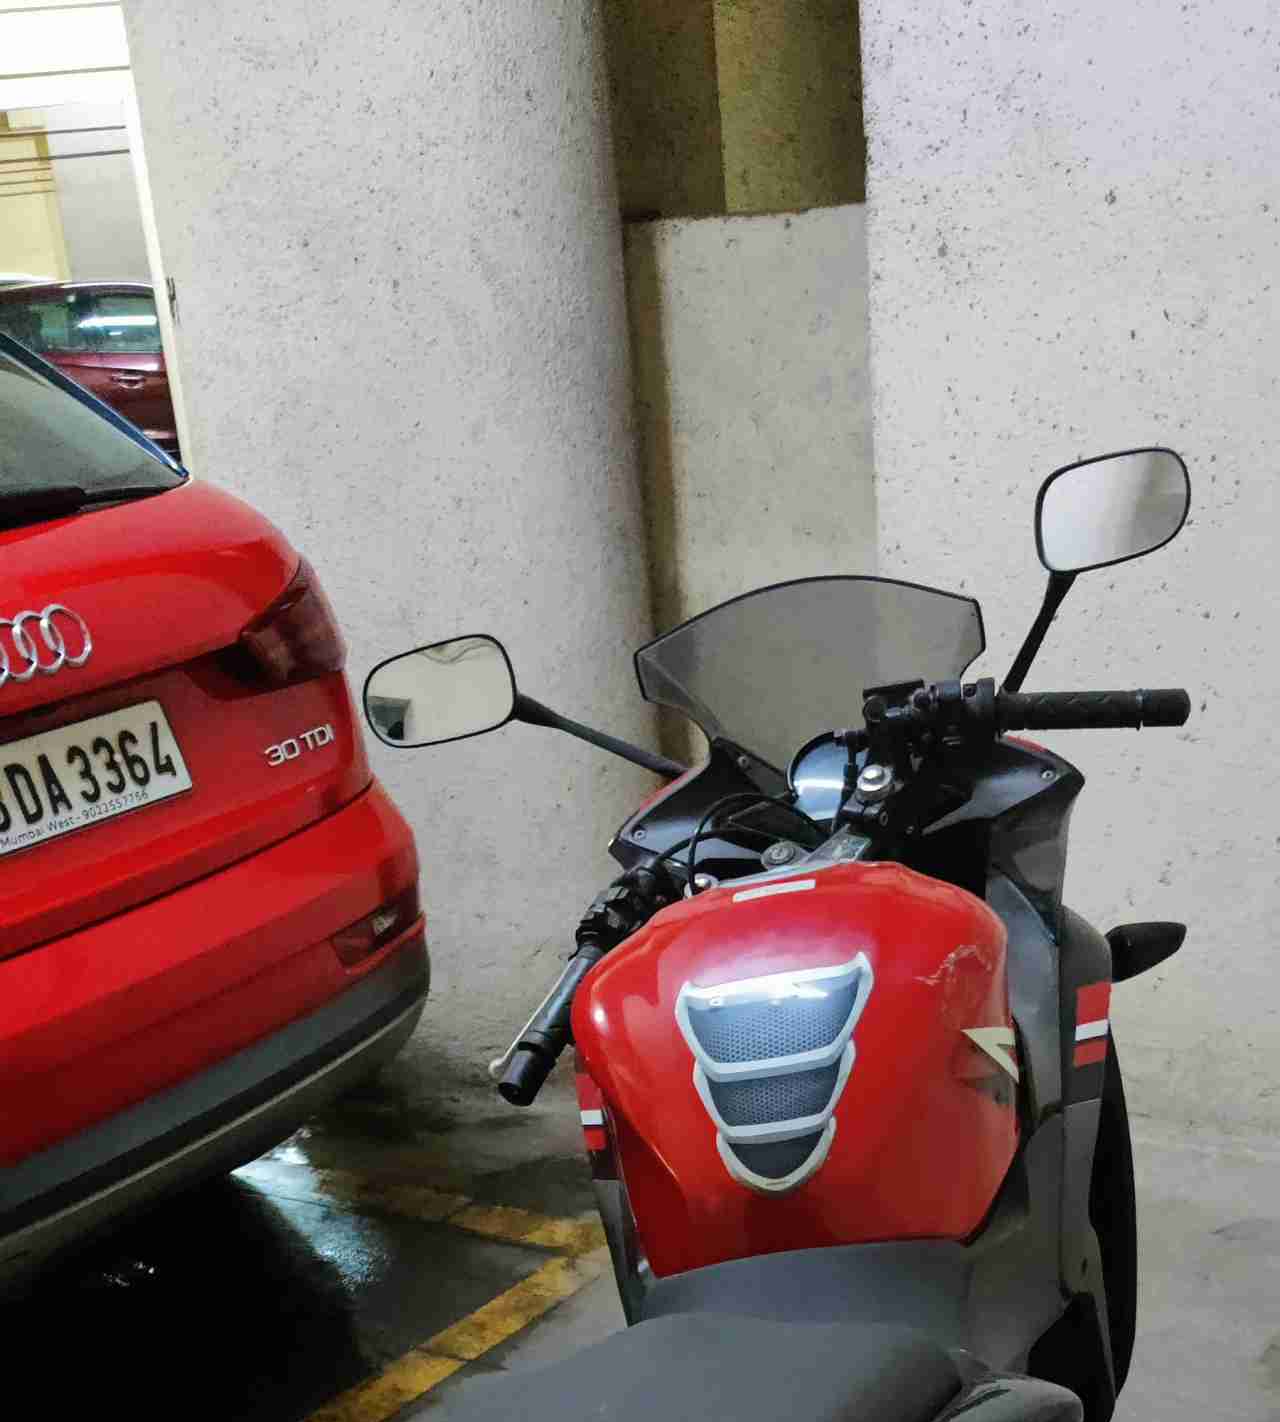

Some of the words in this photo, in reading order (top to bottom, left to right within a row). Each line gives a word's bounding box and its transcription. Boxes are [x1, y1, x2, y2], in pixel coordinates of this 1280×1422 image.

[66, 720, 178, 804] 3364
[264, 738, 300, 767] 30
[300, 723, 334, 751] TDI
